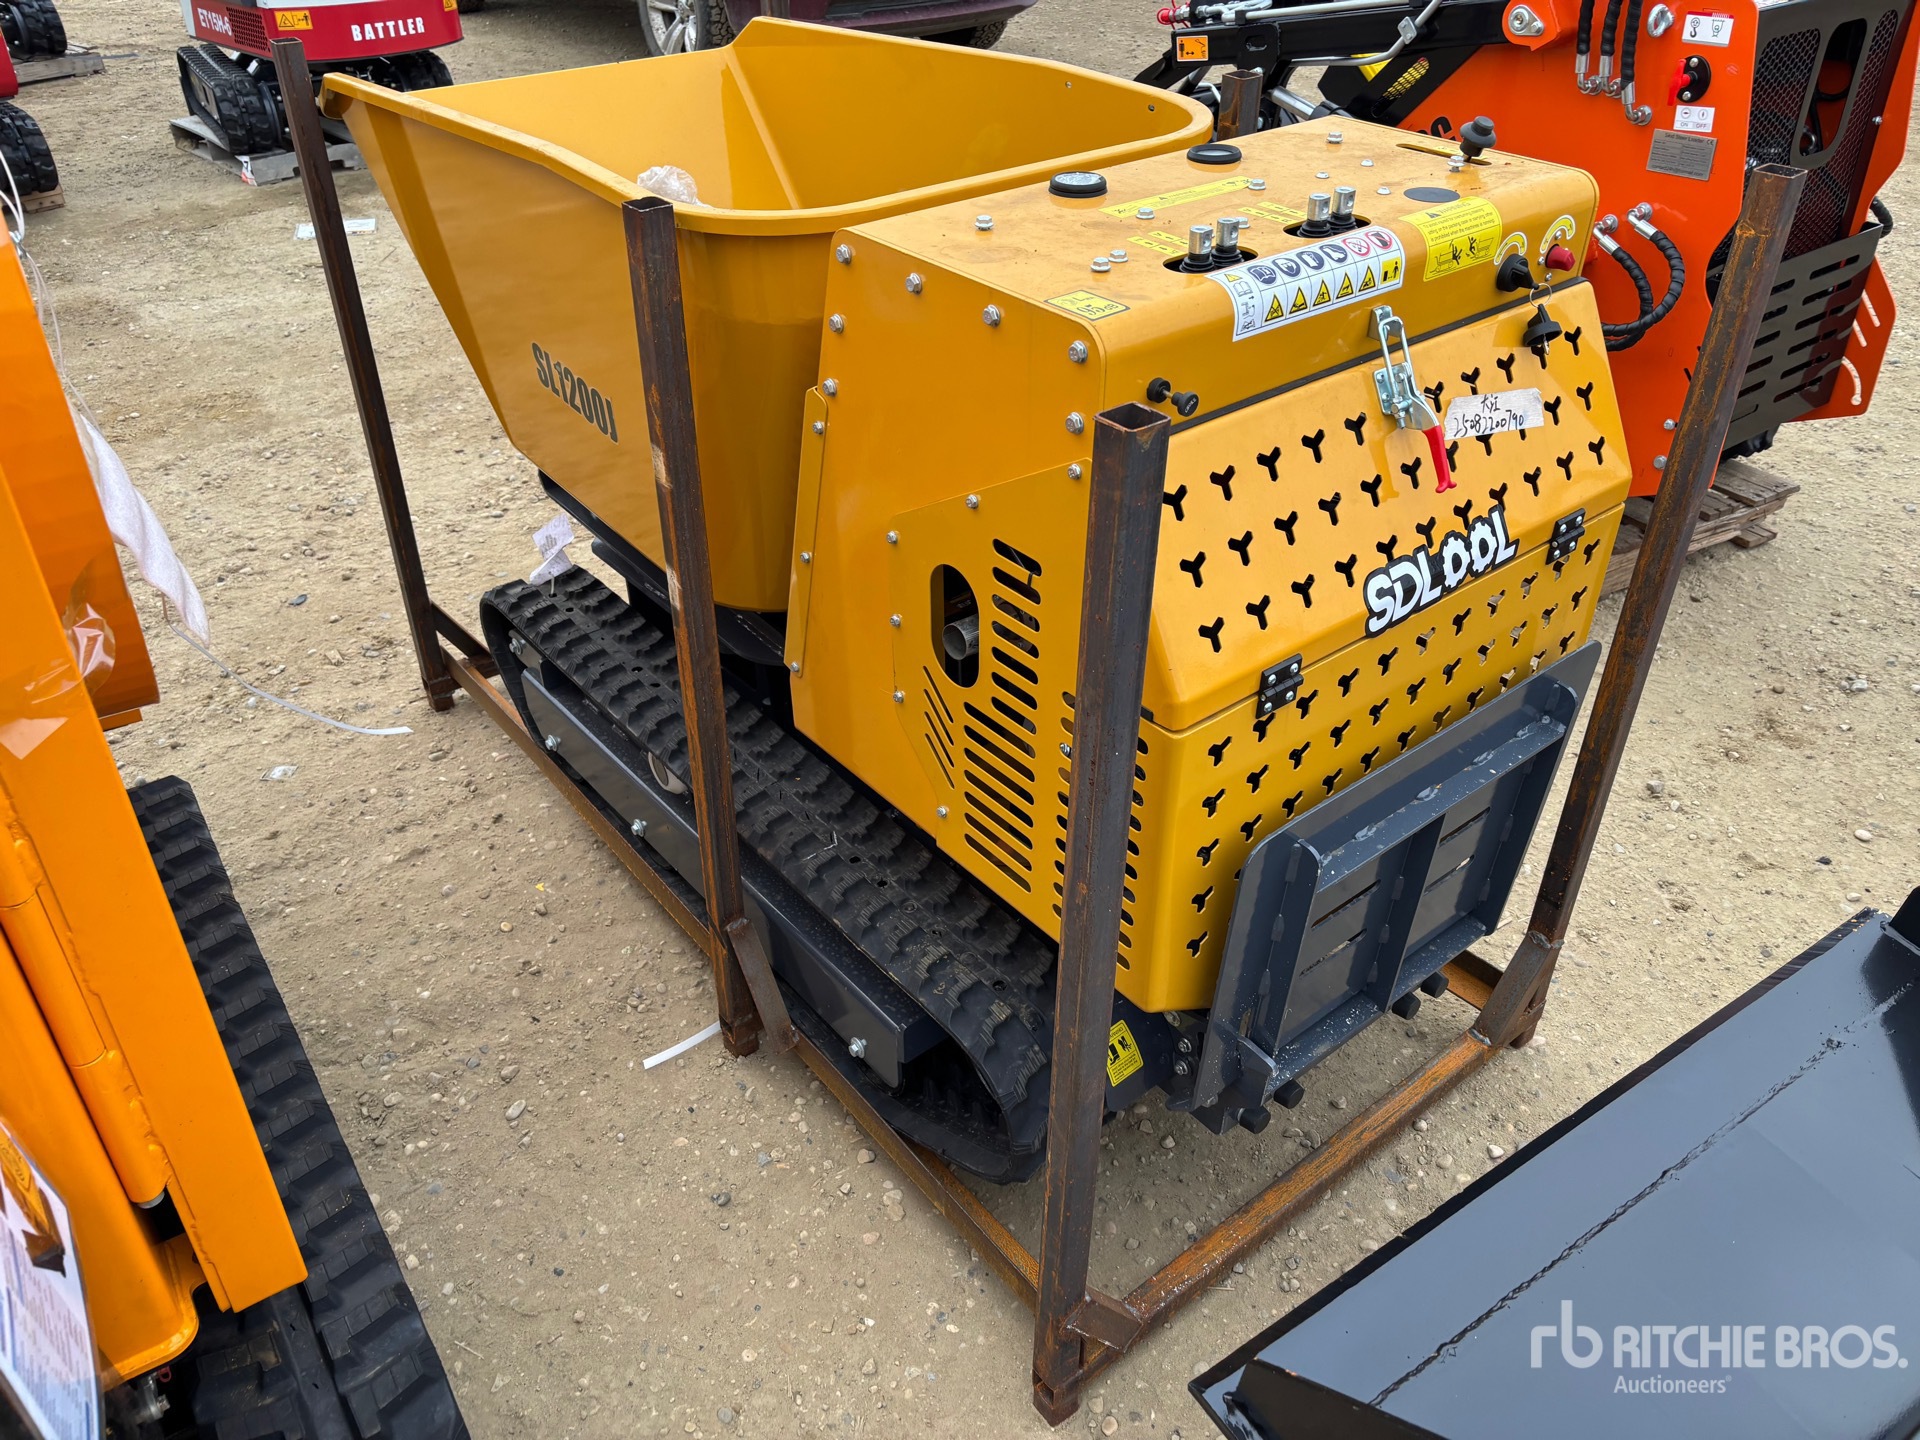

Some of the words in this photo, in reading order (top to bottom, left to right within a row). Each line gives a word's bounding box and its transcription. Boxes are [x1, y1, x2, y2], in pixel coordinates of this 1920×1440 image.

[197, 7, 232, 37] ET15H-6
[351, 17, 425, 42] BATTLER
[531, 342, 618, 443] SL1200J
[1366, 510, 1517, 633] SDLOOL
